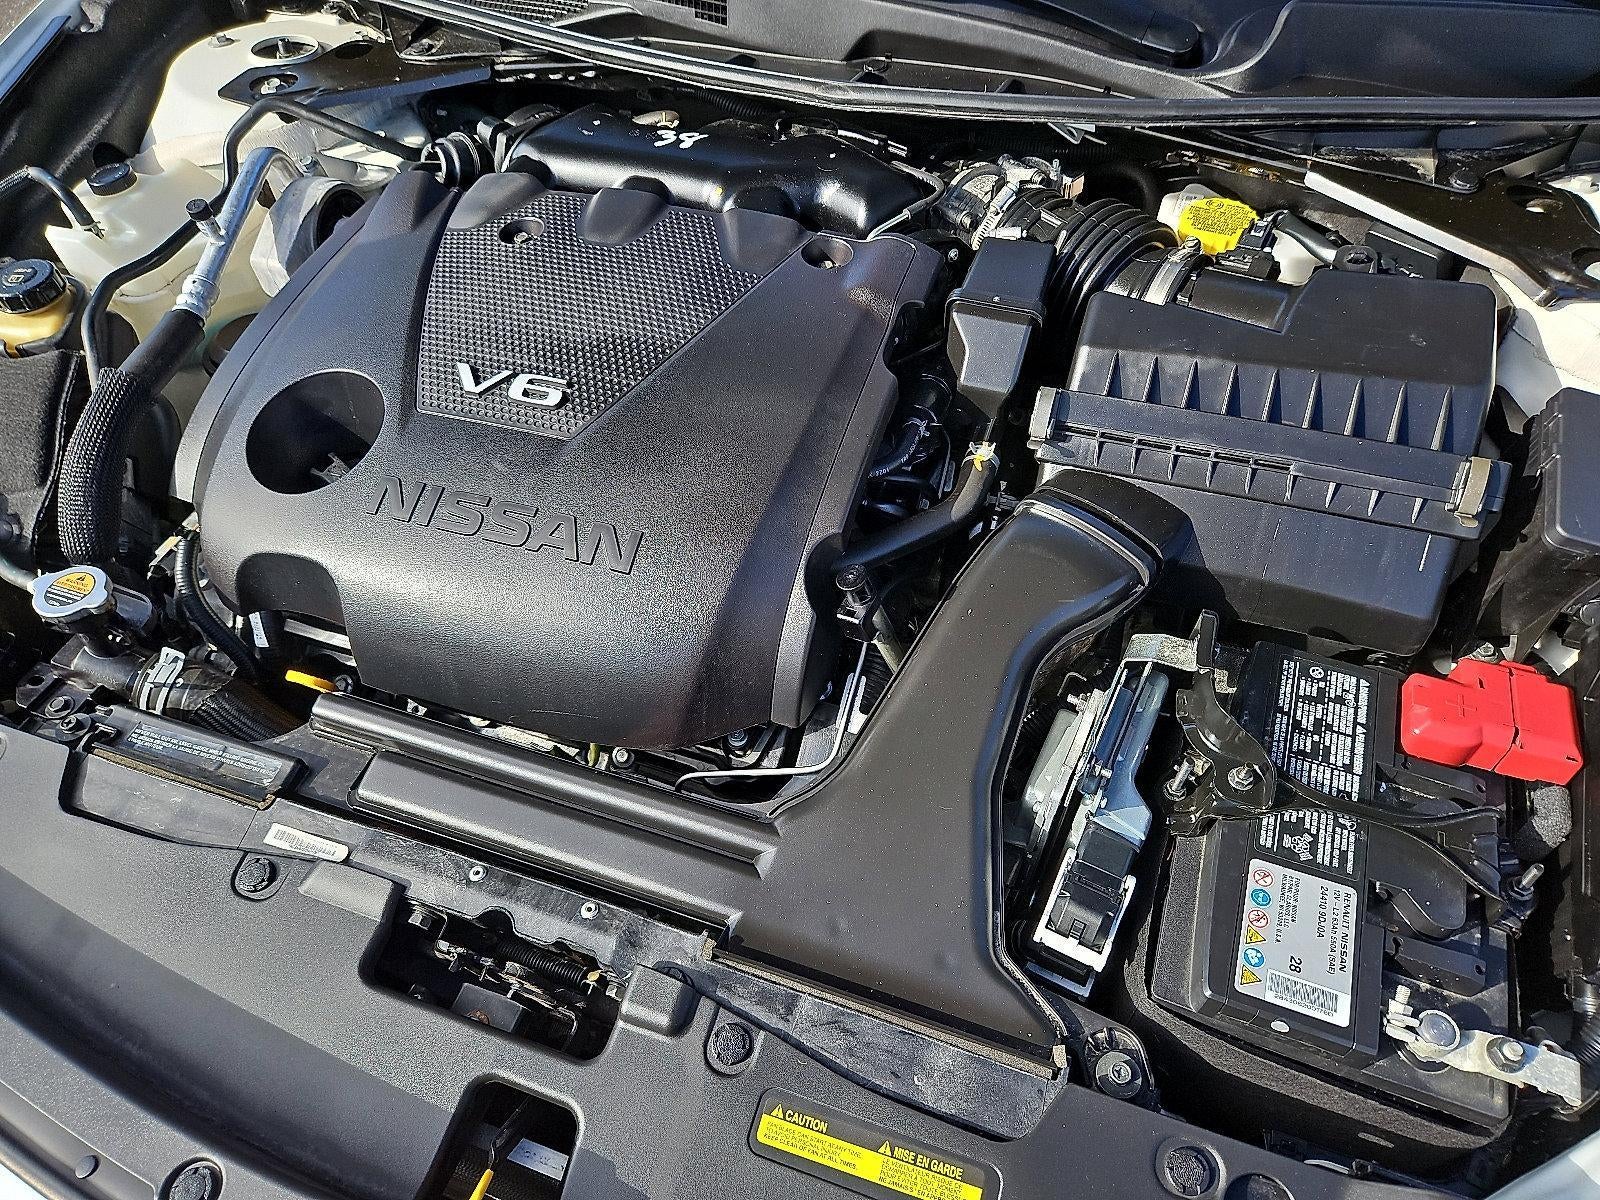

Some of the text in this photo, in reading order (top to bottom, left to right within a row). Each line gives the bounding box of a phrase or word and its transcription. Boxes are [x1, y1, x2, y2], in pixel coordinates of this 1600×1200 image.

[456, 362, 570, 408] V6
[366, 475, 644, 575] NISSAN
[1318, 884, 1328, 910] 24410
[1332, 888, 1340, 901] 12V
[1332, 906, 1338, 917] L2
[1338, 891, 1351, 973] RENAULT NISSAN
[1288, 954, 1302, 974] 28
[1326, 953, 1335, 975] (SAE)
[785, 1109, 828, 1134] CAUTION
[893, 1146, 964, 1181] MISE EN GARDE
